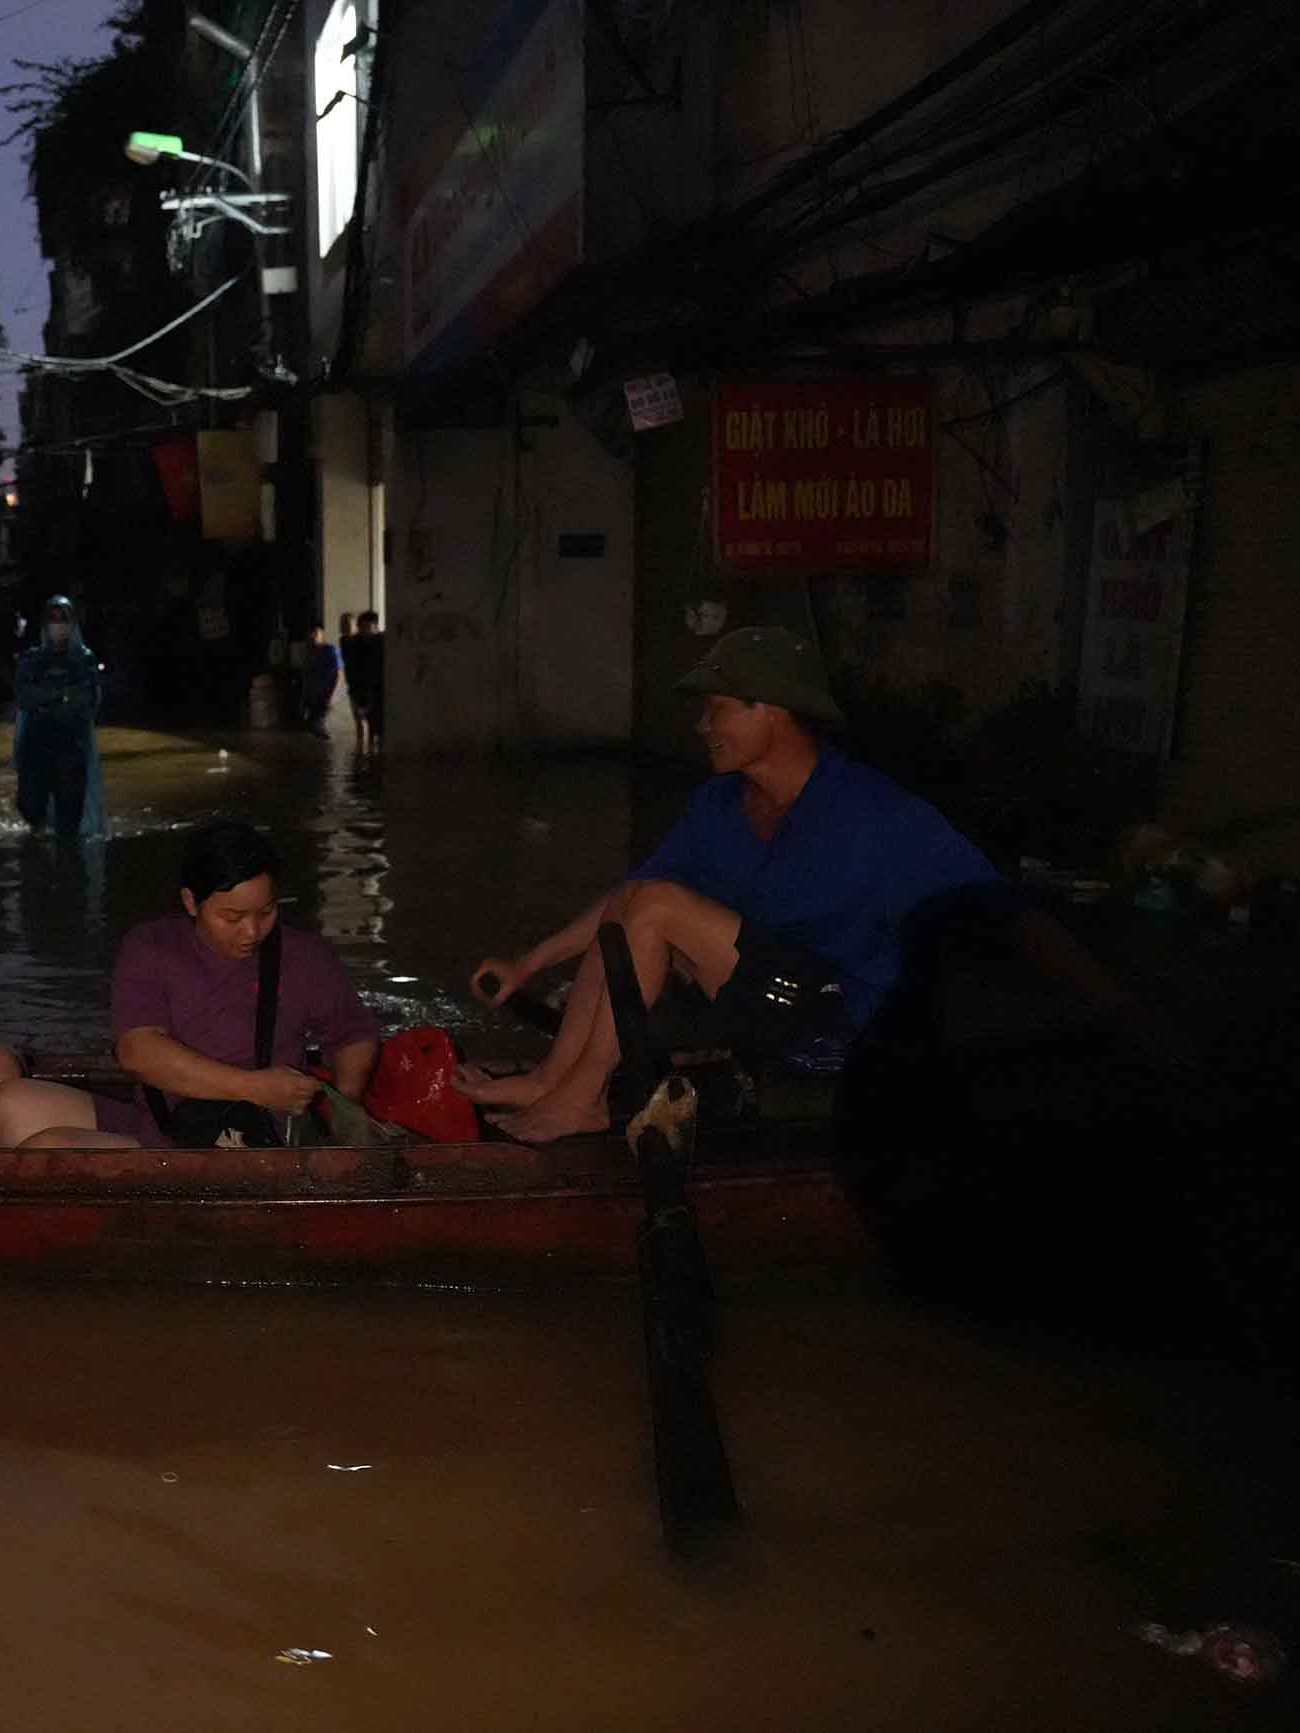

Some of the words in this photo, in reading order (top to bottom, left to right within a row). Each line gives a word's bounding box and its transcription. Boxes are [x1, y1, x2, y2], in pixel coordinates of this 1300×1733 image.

[852, 402, 882, 449] LÀ
[737, 473, 787, 520] LÀM
[845, 472, 876, 520] ÁO
